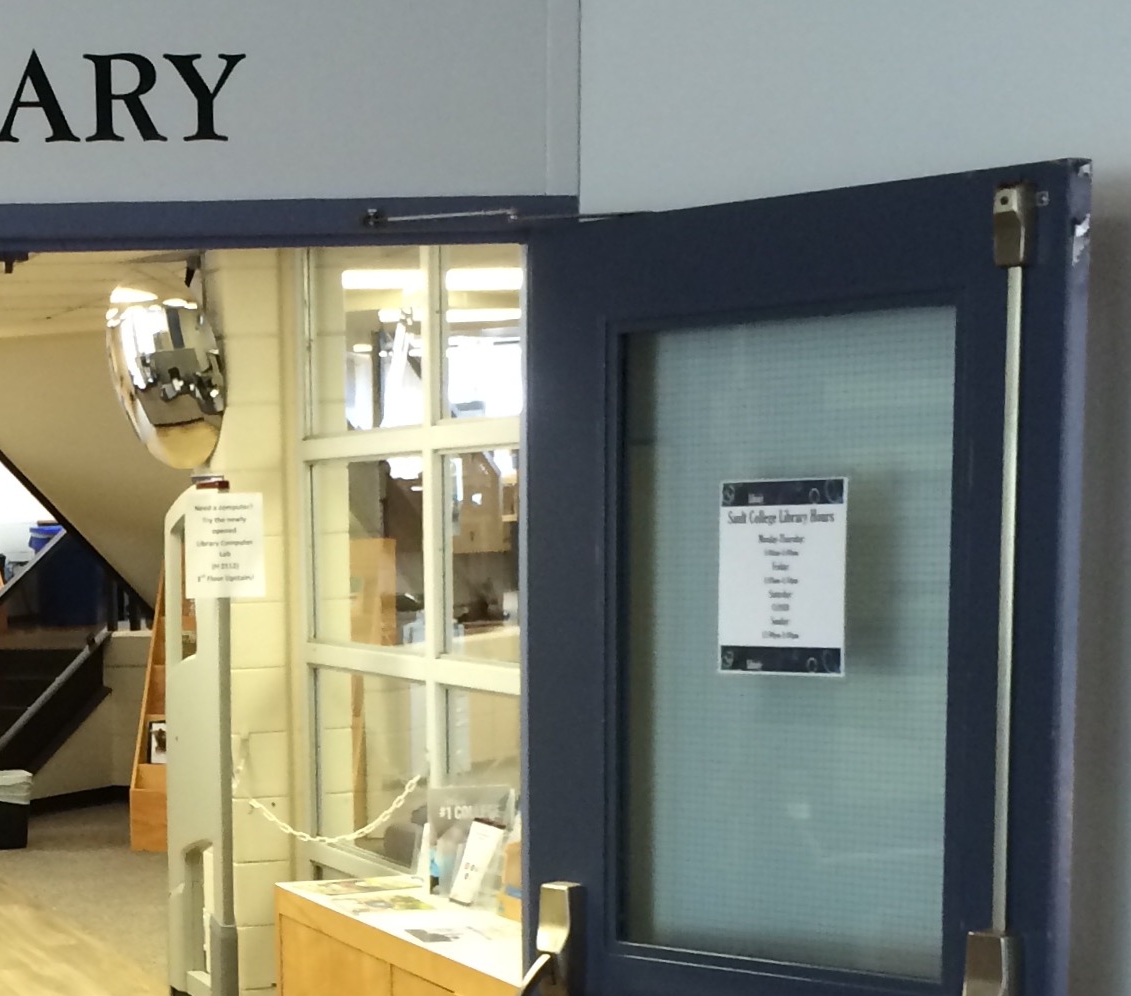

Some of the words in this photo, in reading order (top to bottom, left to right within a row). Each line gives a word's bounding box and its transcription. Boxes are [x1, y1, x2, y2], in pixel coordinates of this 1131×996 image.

[749, 509, 777, 526] College
[779, 509, 808, 525] Library
[810, 508, 835, 523] Hours
